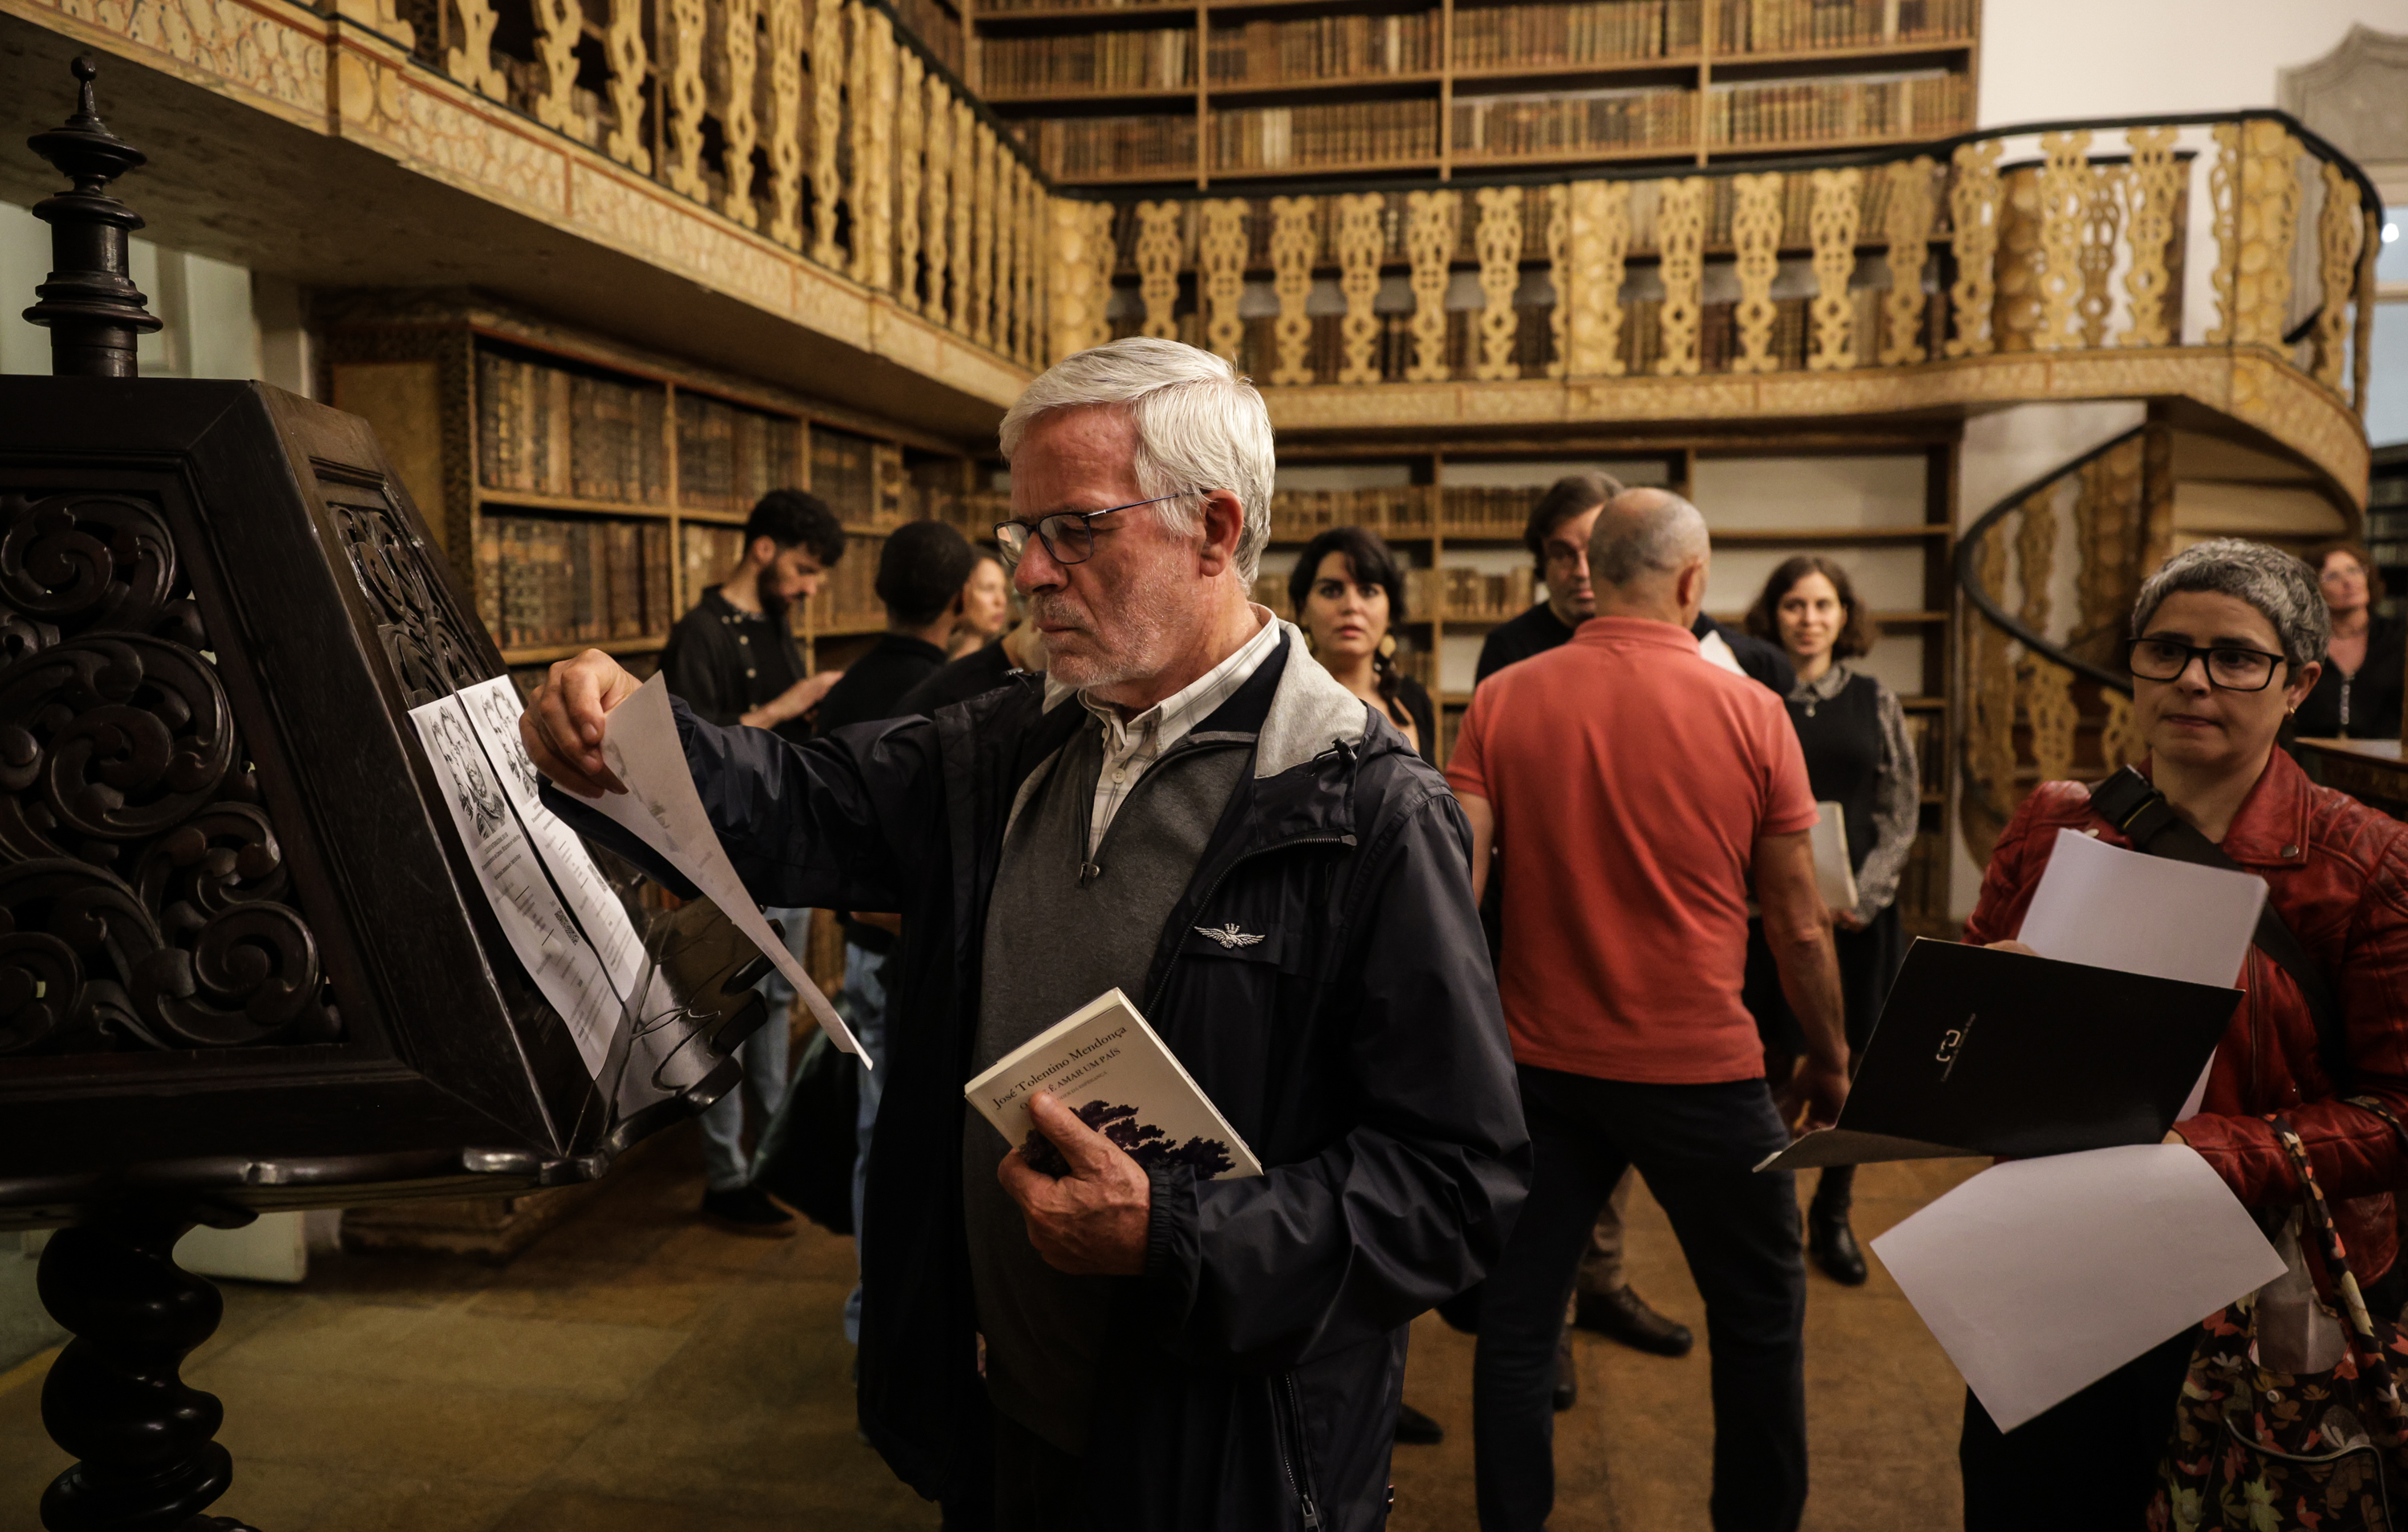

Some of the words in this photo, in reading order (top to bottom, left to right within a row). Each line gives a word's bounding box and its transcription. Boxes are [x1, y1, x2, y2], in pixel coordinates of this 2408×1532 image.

[993, 1089, 1017, 1110] José
[1015, 1059, 1069, 1091] Tolentino
[1068, 1027, 1127, 1061] Mendonça
[1057, 1069, 1084, 1088] AMAR
[1083, 1060, 1100, 1072] UM
[1099, 1047, 1121, 1063] PAÍS
